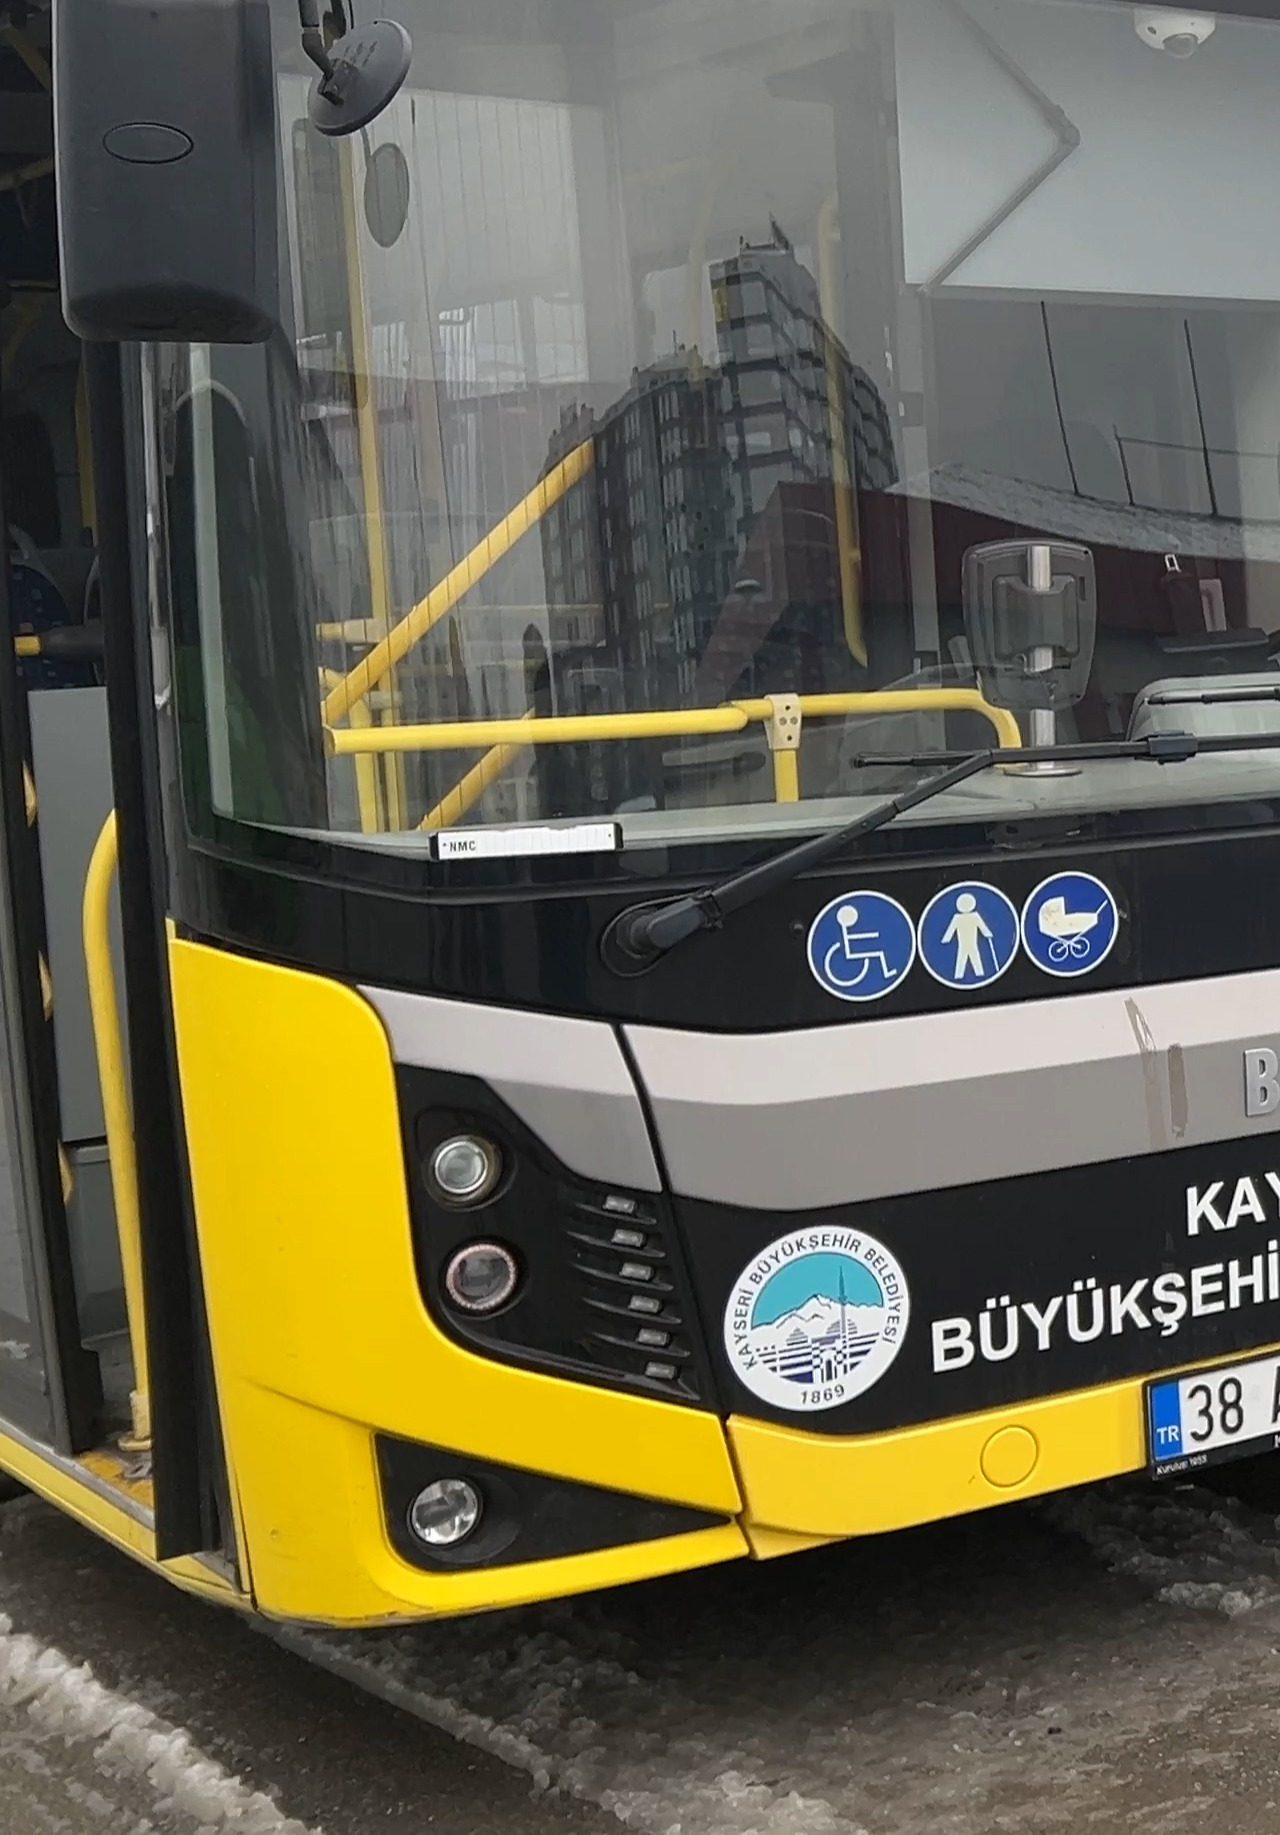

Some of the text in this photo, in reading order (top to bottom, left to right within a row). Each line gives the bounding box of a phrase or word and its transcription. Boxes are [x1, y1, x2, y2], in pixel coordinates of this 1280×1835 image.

[733, 1234, 904, 1370] KAYSERİ BÜYÜKŞEHİR BELEDİYESİ
[800, 1384, 845, 1405] 1869
[1187, 1376, 1244, 1442] 38
[1156, 1424, 1180, 1445] TR
